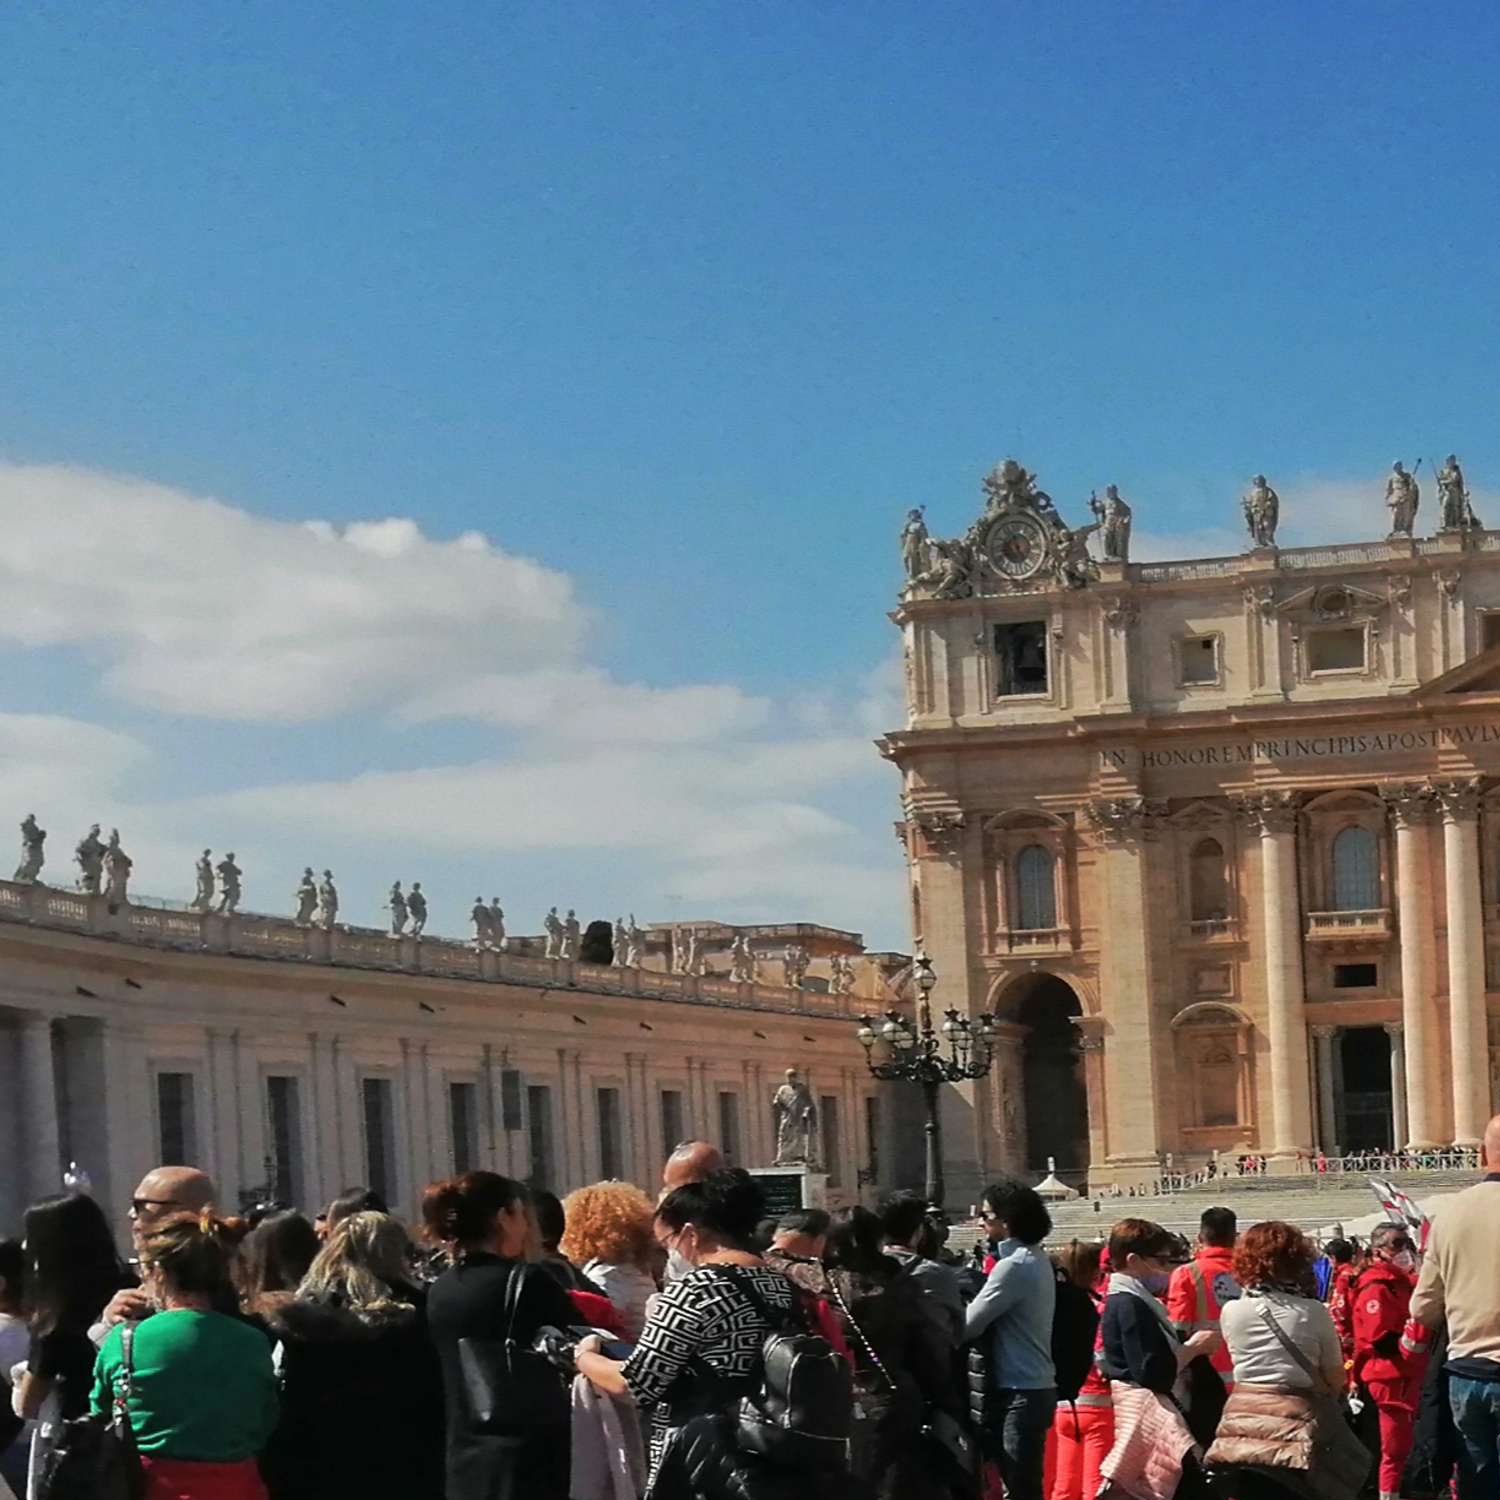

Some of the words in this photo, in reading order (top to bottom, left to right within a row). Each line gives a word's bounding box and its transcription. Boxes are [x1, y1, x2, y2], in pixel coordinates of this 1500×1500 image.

[1142, 744, 1253, 768] HONOREM
[1255, 735, 1367, 758] PRINCIPIS
[1371, 729, 1439, 750] APOST
